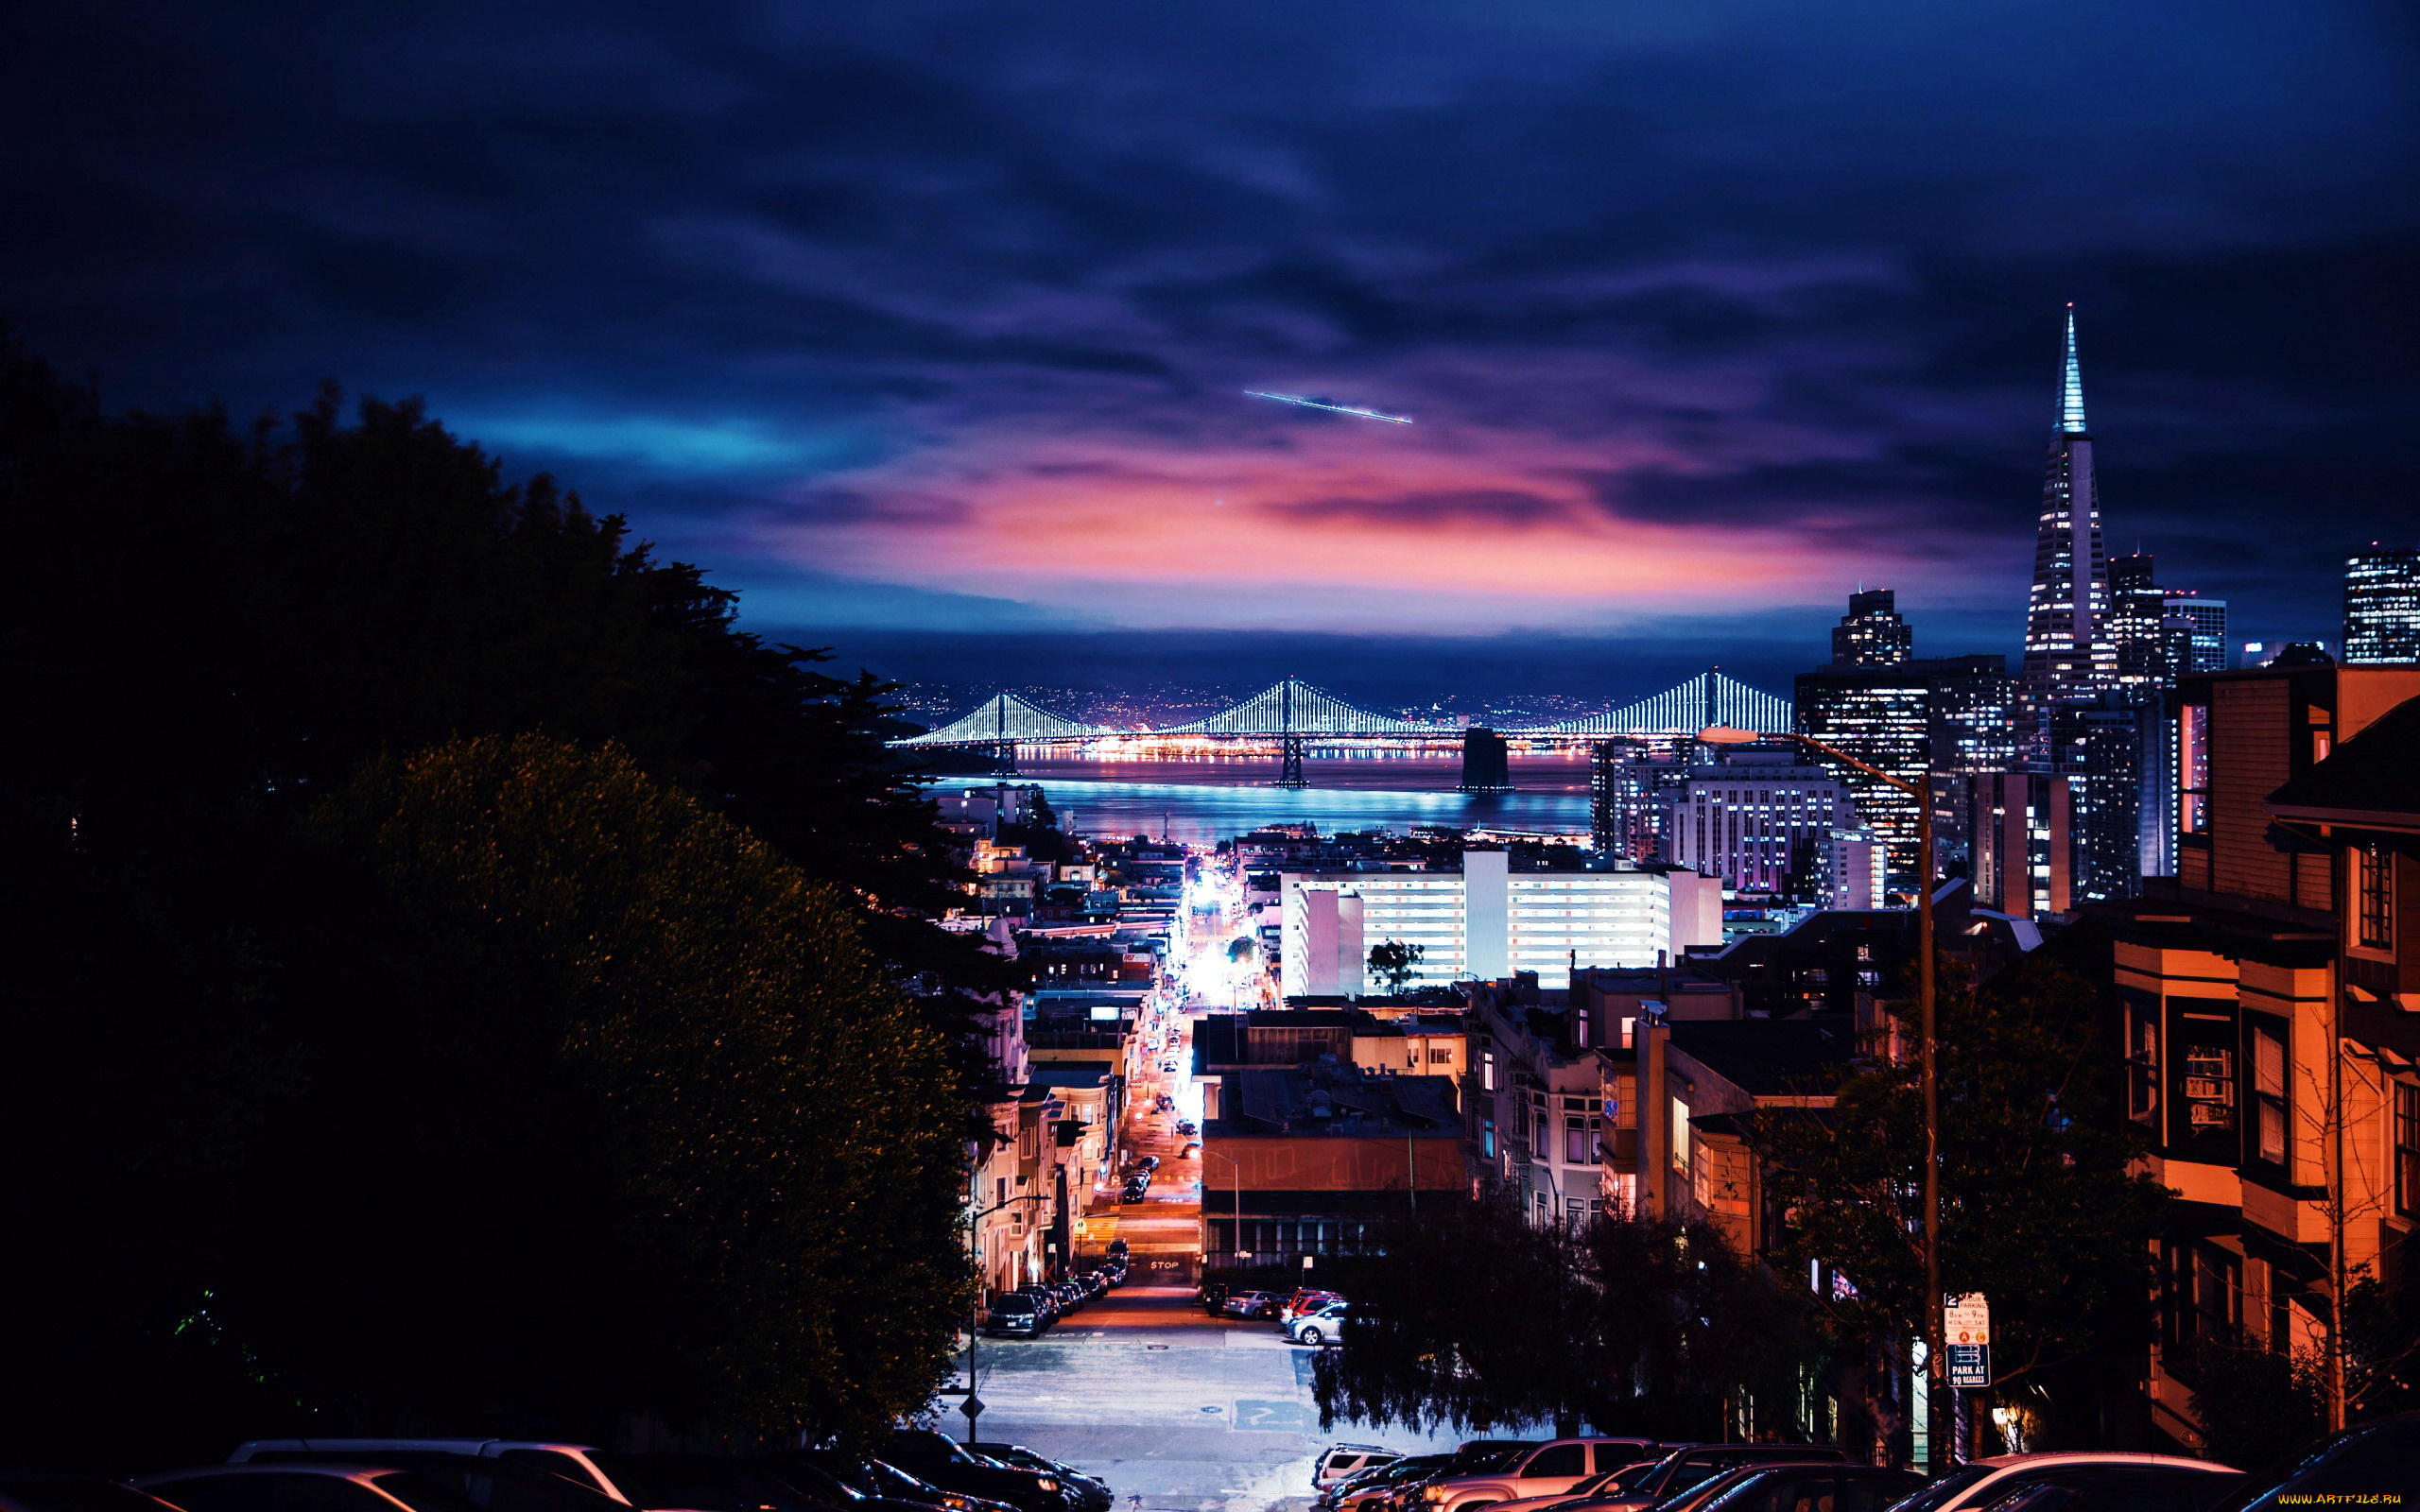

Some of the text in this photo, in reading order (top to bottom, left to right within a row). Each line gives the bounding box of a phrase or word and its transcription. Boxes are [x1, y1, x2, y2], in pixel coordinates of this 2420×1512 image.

[1947, 1296, 1957, 1306] 2
[1952, 1366, 1985, 1375] PARK AT
[1952, 1375, 1985, 1385] 90 DEGREES
